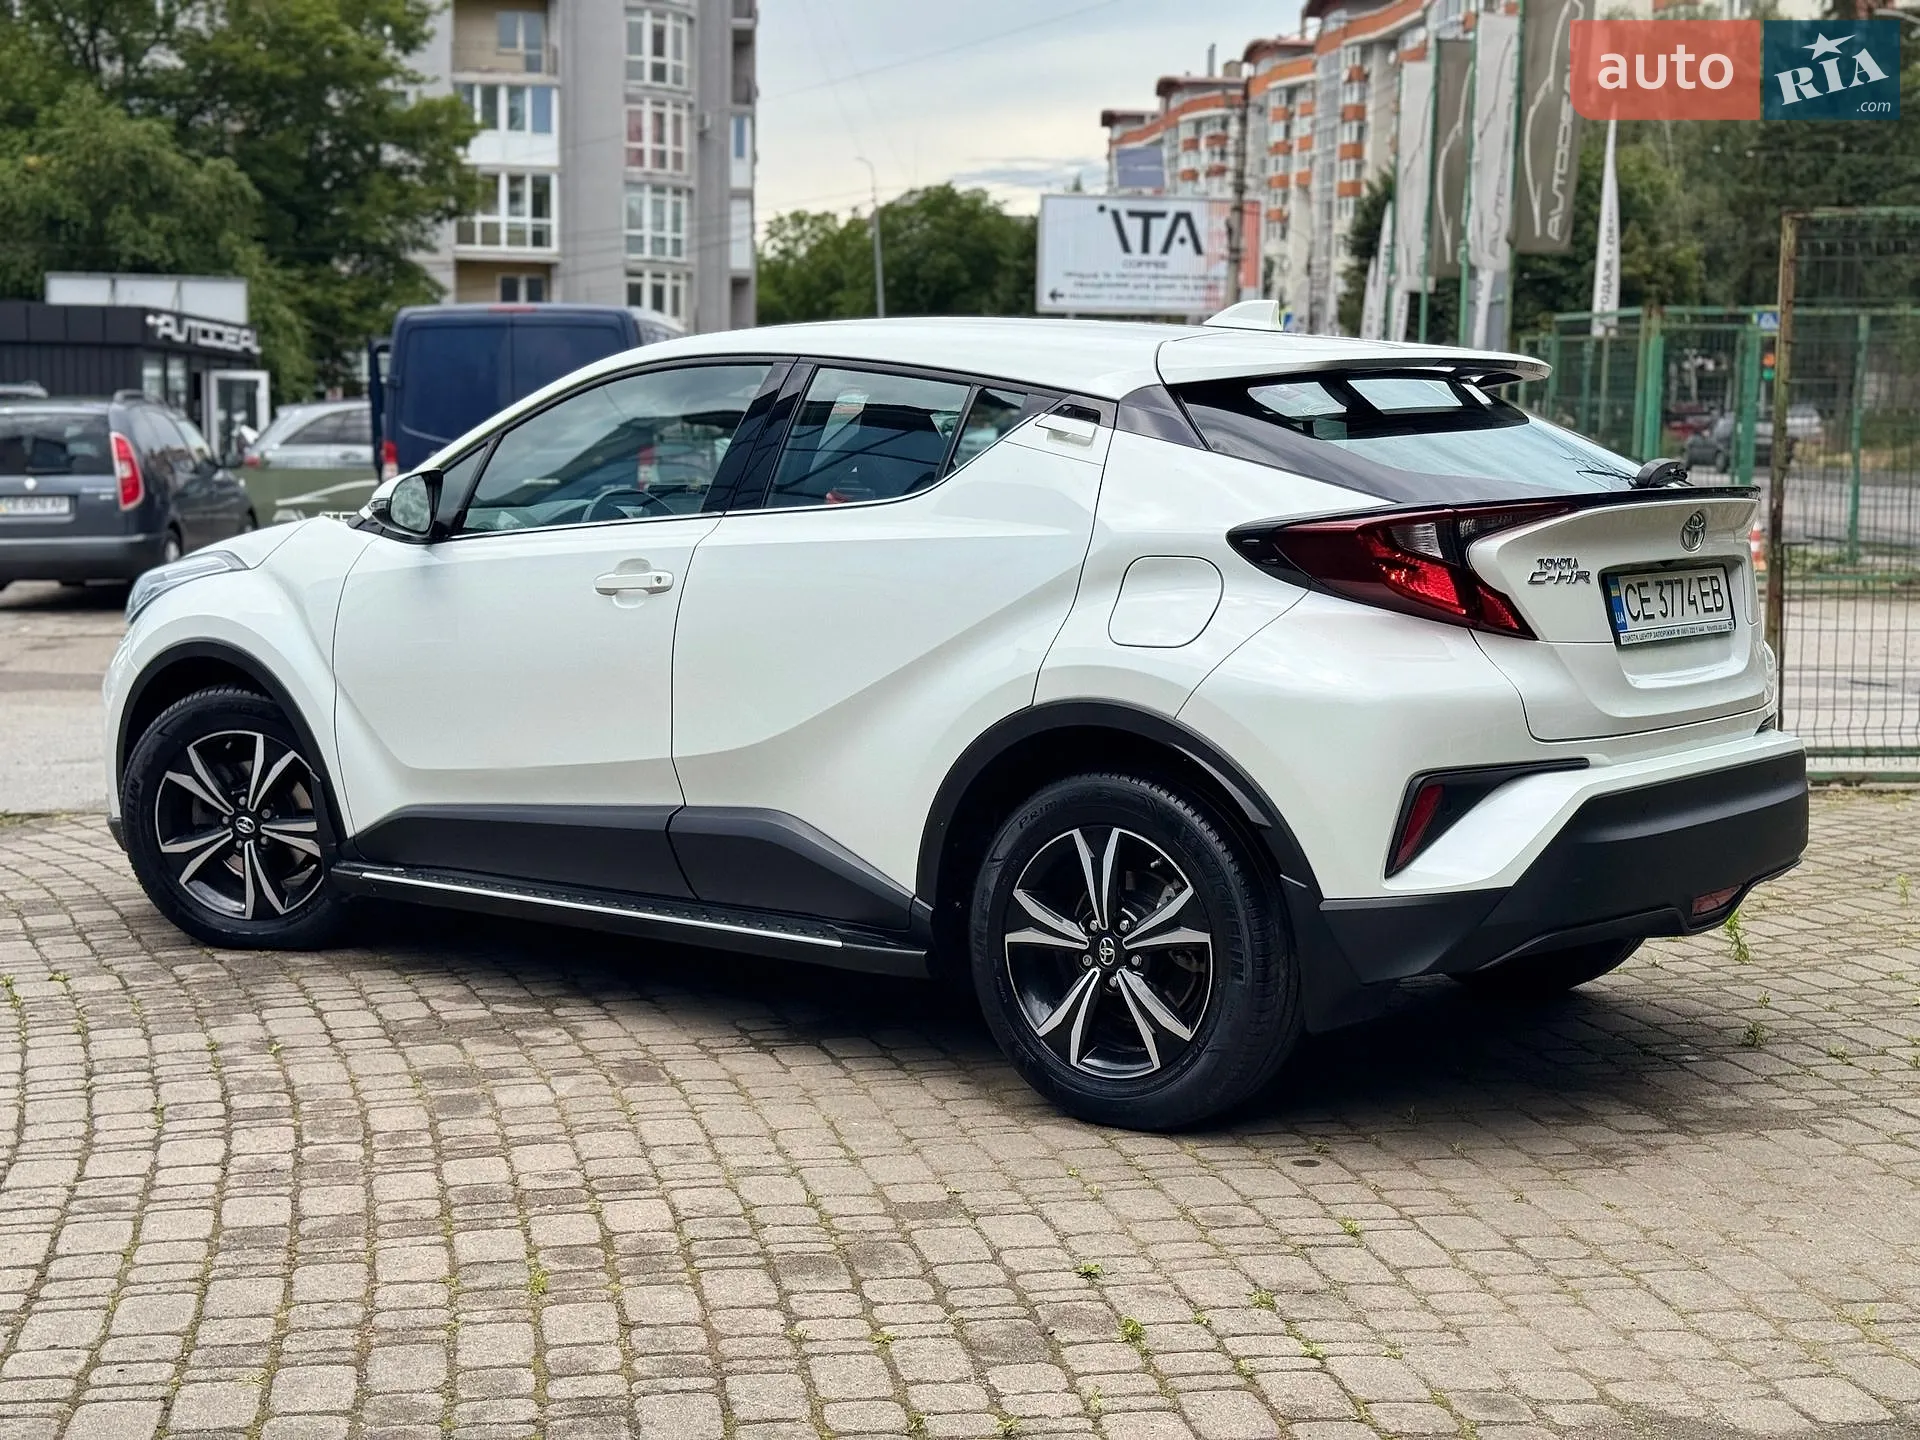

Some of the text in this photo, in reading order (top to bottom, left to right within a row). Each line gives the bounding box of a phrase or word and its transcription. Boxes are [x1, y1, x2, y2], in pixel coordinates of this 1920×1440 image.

[1537, 557, 1579, 570] TOYOTA
[1528, 570, 1590, 585] C-HR
[1625, 575, 1724, 622] CE 3774 EB
[1615, 611, 1626, 624] UA
